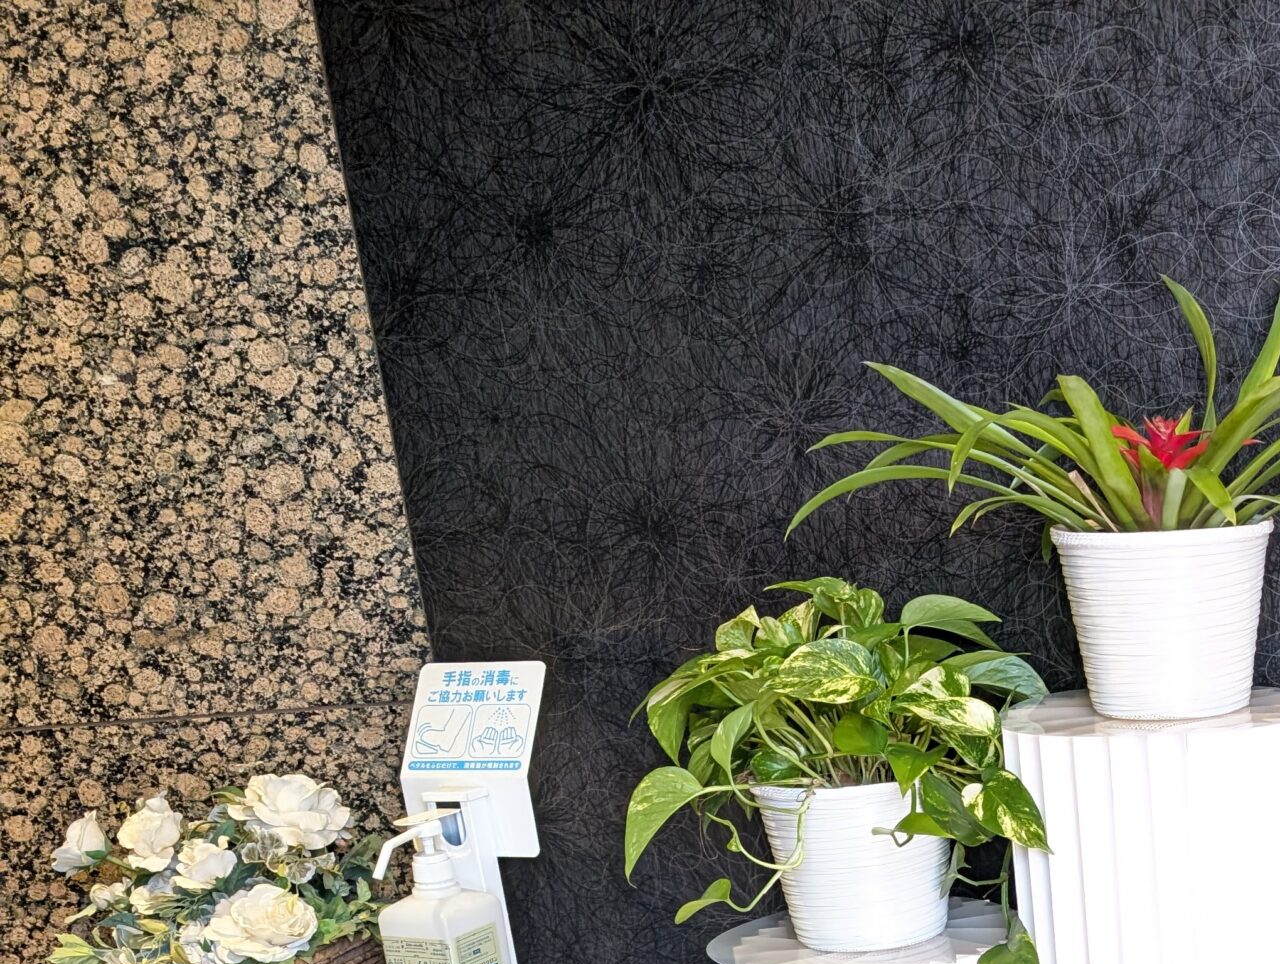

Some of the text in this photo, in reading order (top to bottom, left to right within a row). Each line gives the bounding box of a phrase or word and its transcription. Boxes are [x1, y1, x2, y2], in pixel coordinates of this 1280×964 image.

[442, 669, 519, 687] 手指の消毒に
[427, 689, 528, 703] ご協力お願いします
